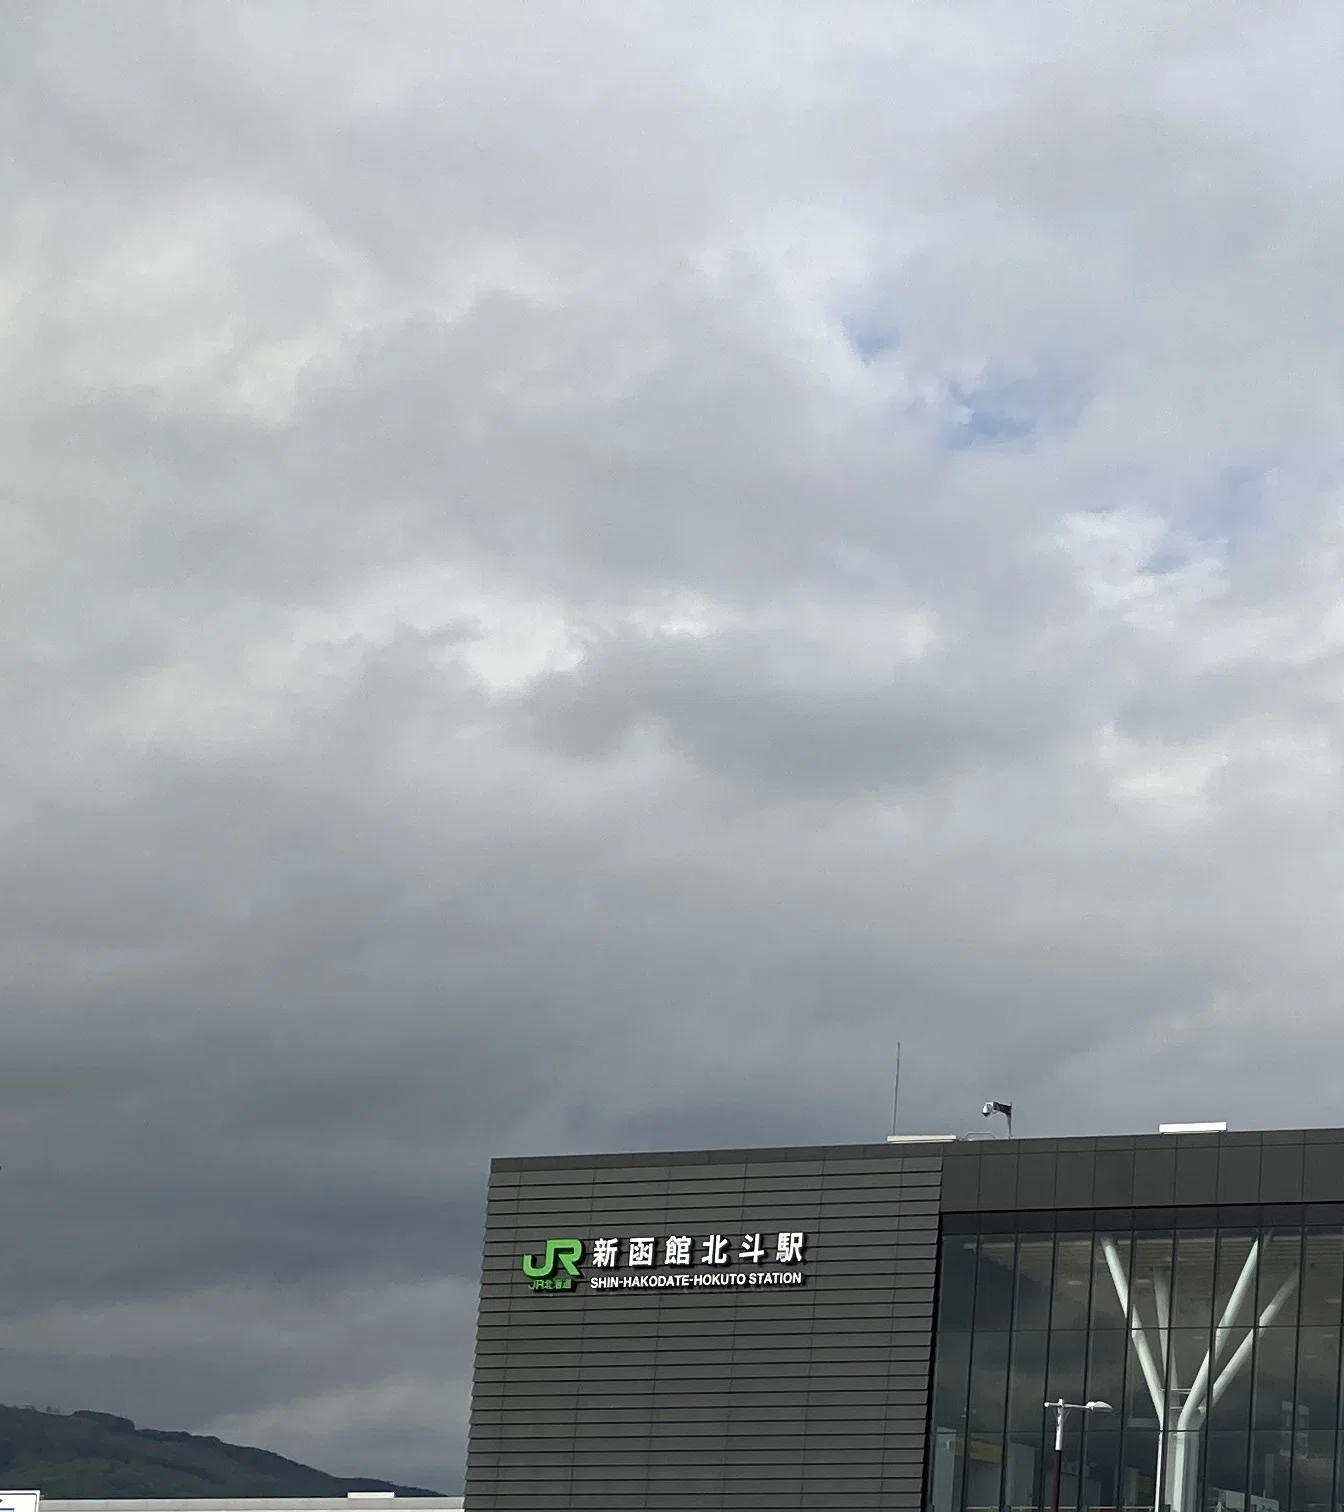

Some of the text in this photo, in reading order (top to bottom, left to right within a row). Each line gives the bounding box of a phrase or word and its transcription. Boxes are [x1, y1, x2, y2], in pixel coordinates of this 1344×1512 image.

[523, 1239, 582, 1277] JR
[592, 1231, 804, 1268] 新函館北斗駅
[590, 1271, 803, 1289] SHIN-HAKODATE-HOKUTO STATION
